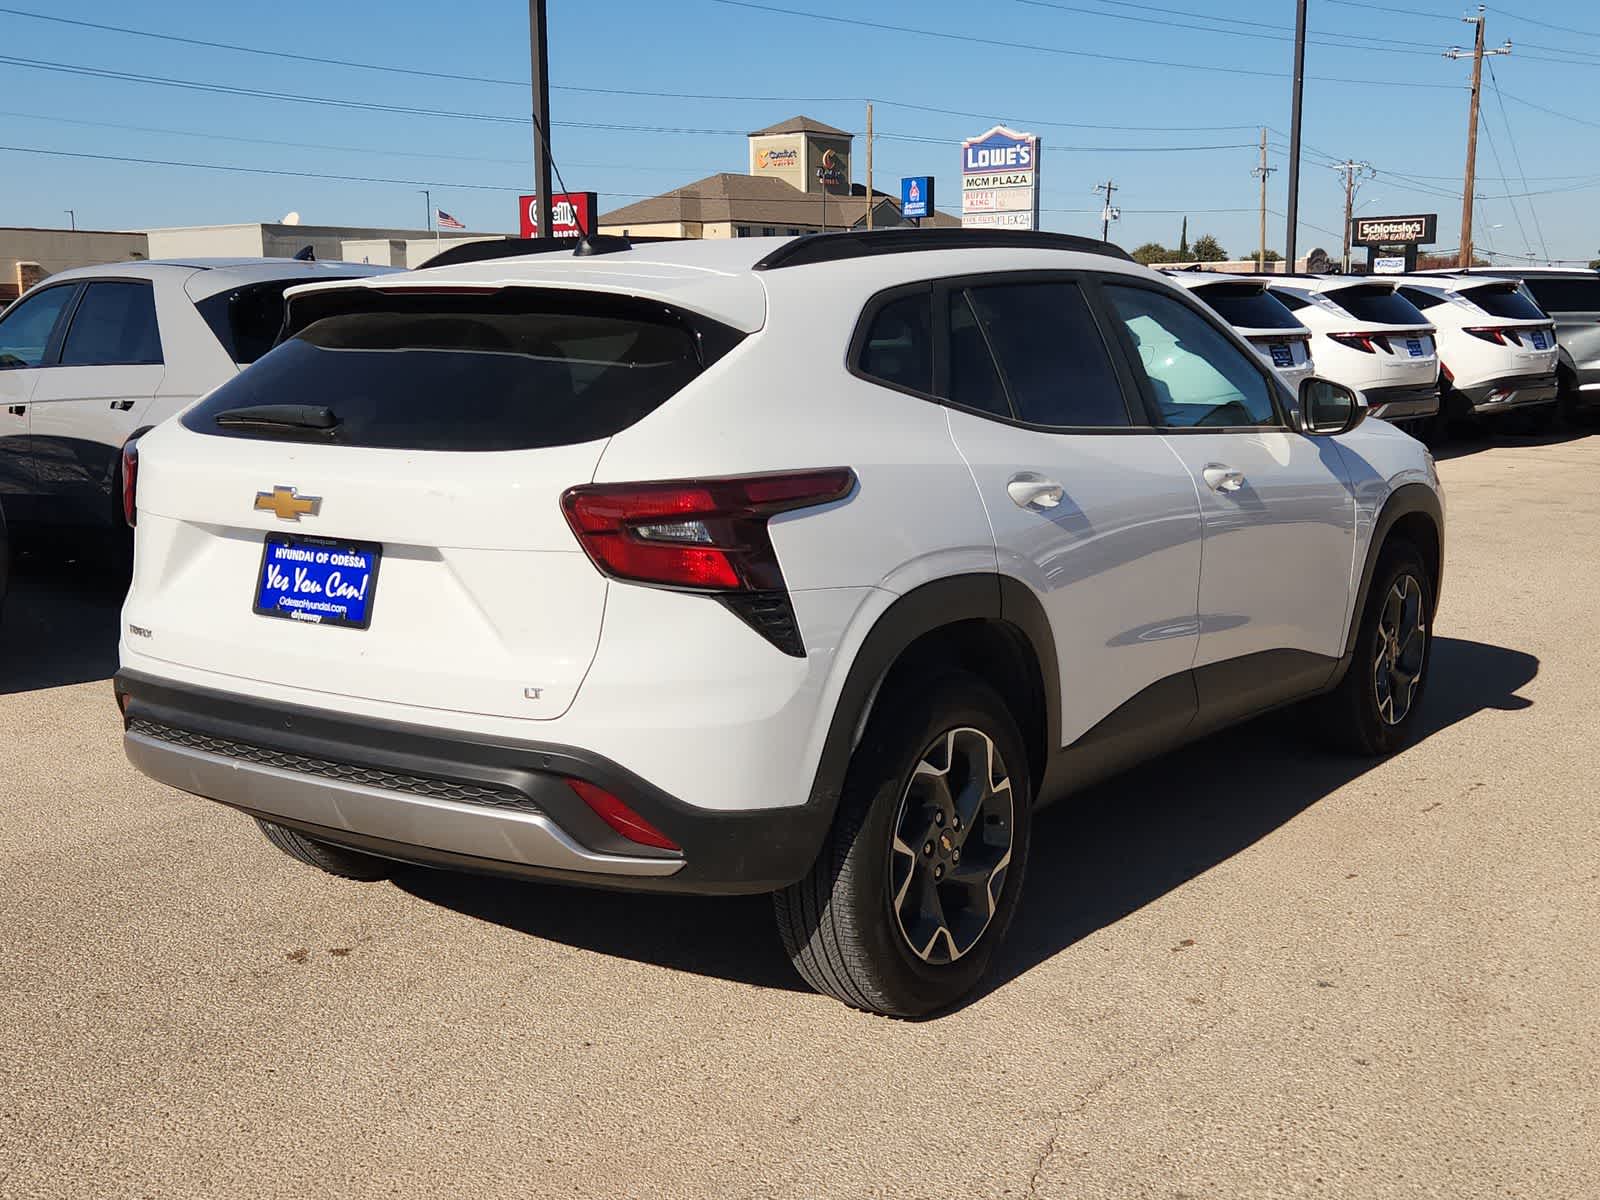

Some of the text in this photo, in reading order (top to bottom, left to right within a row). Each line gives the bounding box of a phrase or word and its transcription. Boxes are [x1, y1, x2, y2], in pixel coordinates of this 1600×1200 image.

[967, 144, 1030, 168] LOWE'S
[966, 175, 1027, 187] MCM PLAZA
[553, 230, 579, 238] PARTS
[1363, 222, 1420, 234] Schlotzsky's
[275, 547, 366, 568] HYUNDAI OF ODESSA
[266, 563, 369, 600] Yes You Can!
[279, 596, 347, 613] OdessaHyundai.com
[291, 609, 322, 623] driveway
[524, 687, 544, 699] LT
